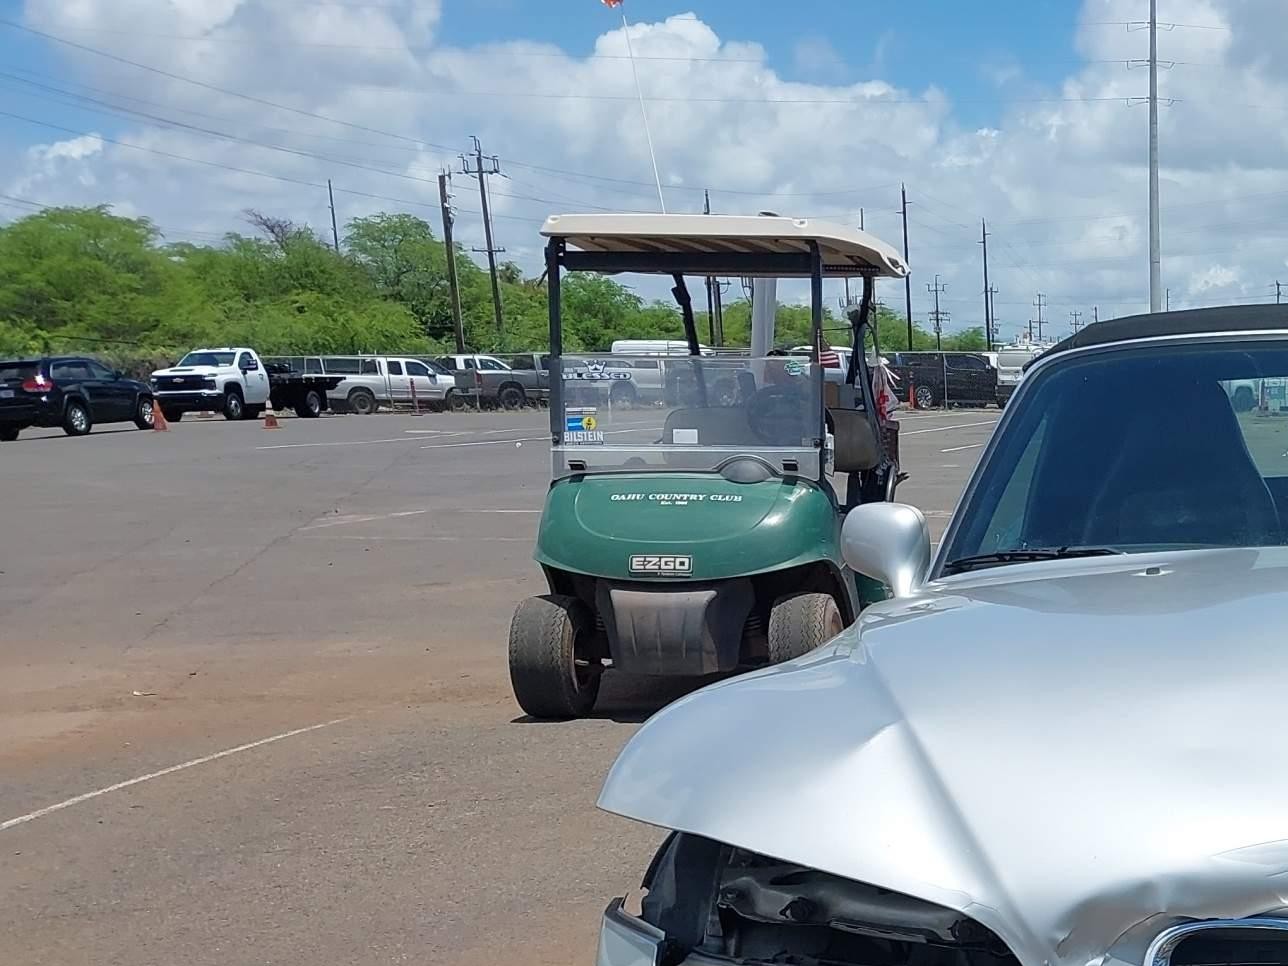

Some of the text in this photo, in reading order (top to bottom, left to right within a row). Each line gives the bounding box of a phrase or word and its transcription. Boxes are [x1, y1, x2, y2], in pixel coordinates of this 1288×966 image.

[561, 371, 631, 380] BLESSED
[564, 431, 604, 441] BILSTEIN
[648, 493, 707, 501] COUNTRY
[709, 494, 743, 502] CLUB
